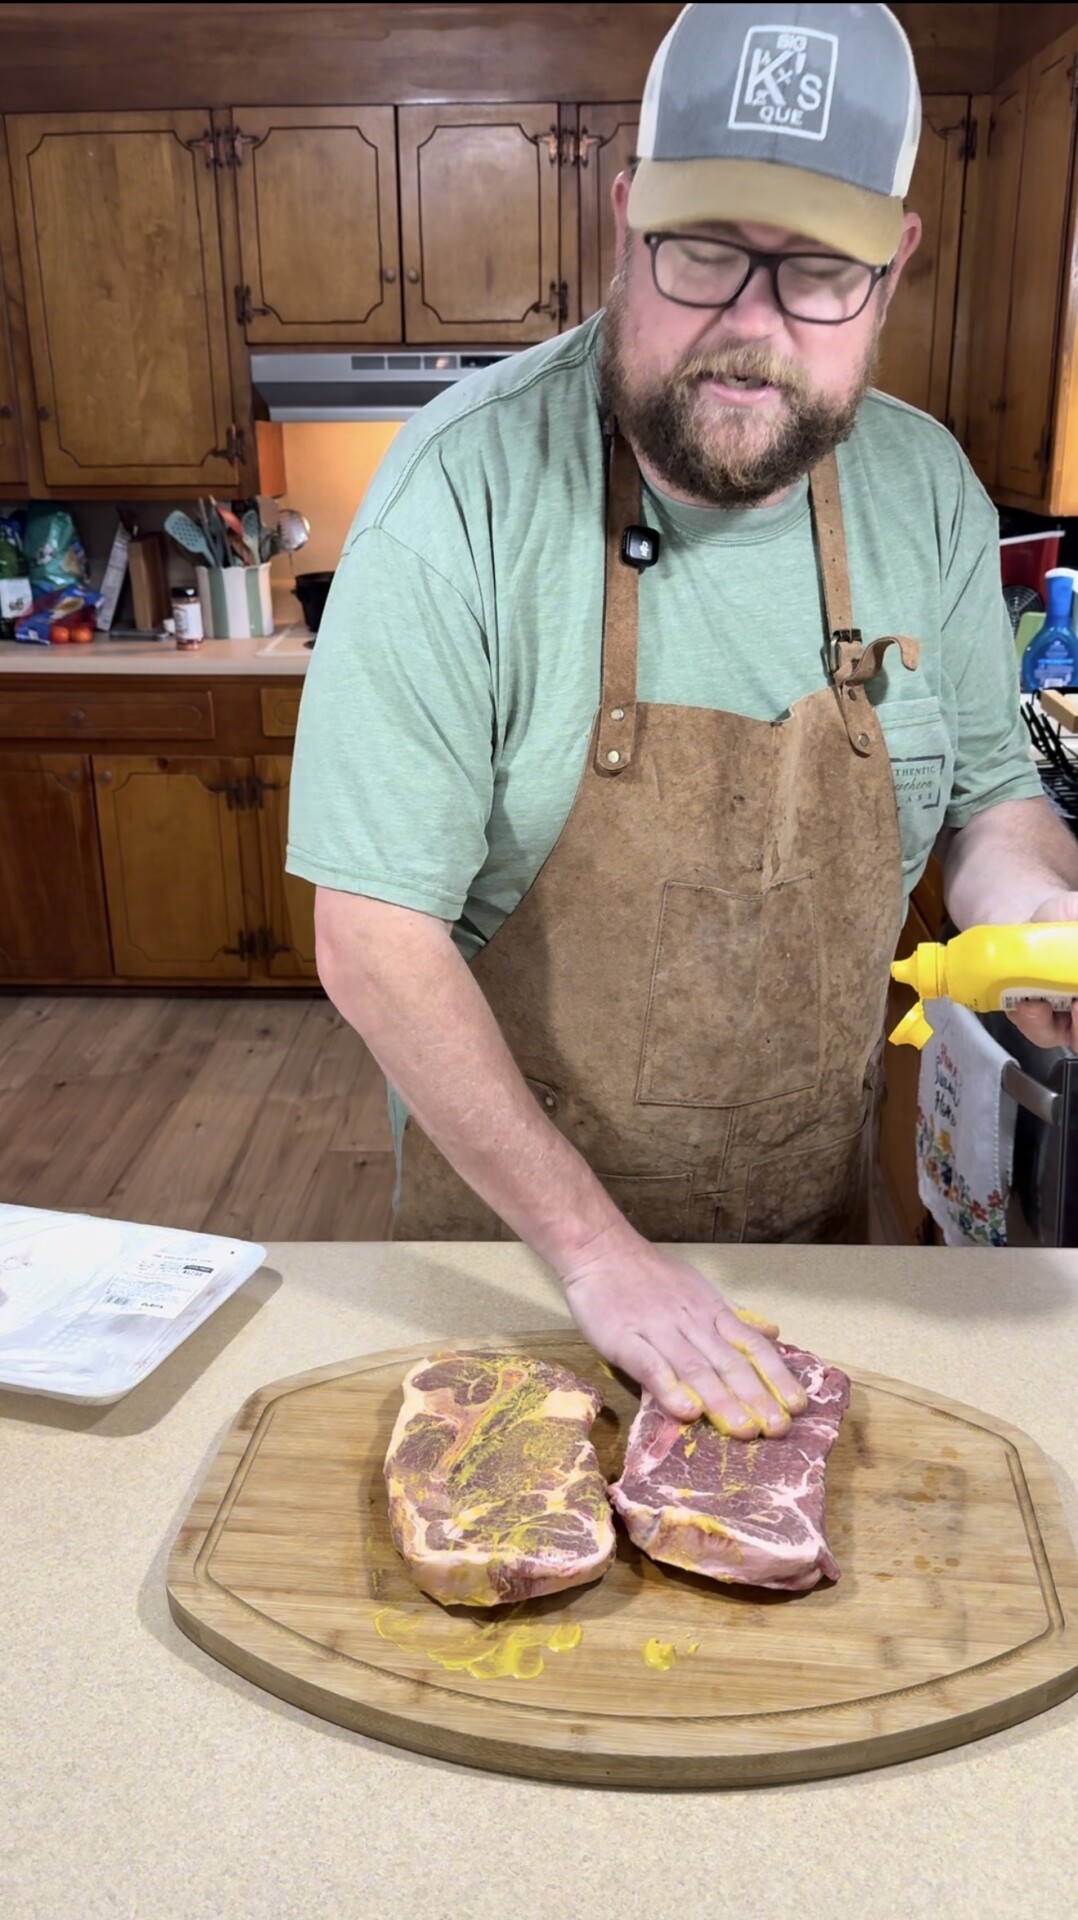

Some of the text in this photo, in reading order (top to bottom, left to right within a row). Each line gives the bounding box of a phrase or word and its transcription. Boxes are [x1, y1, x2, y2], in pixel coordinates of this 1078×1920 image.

[776, 33, 807, 52] BIG
[759, 105, 804, 126] QUE
[895, 765, 936, 777] THENTIC
